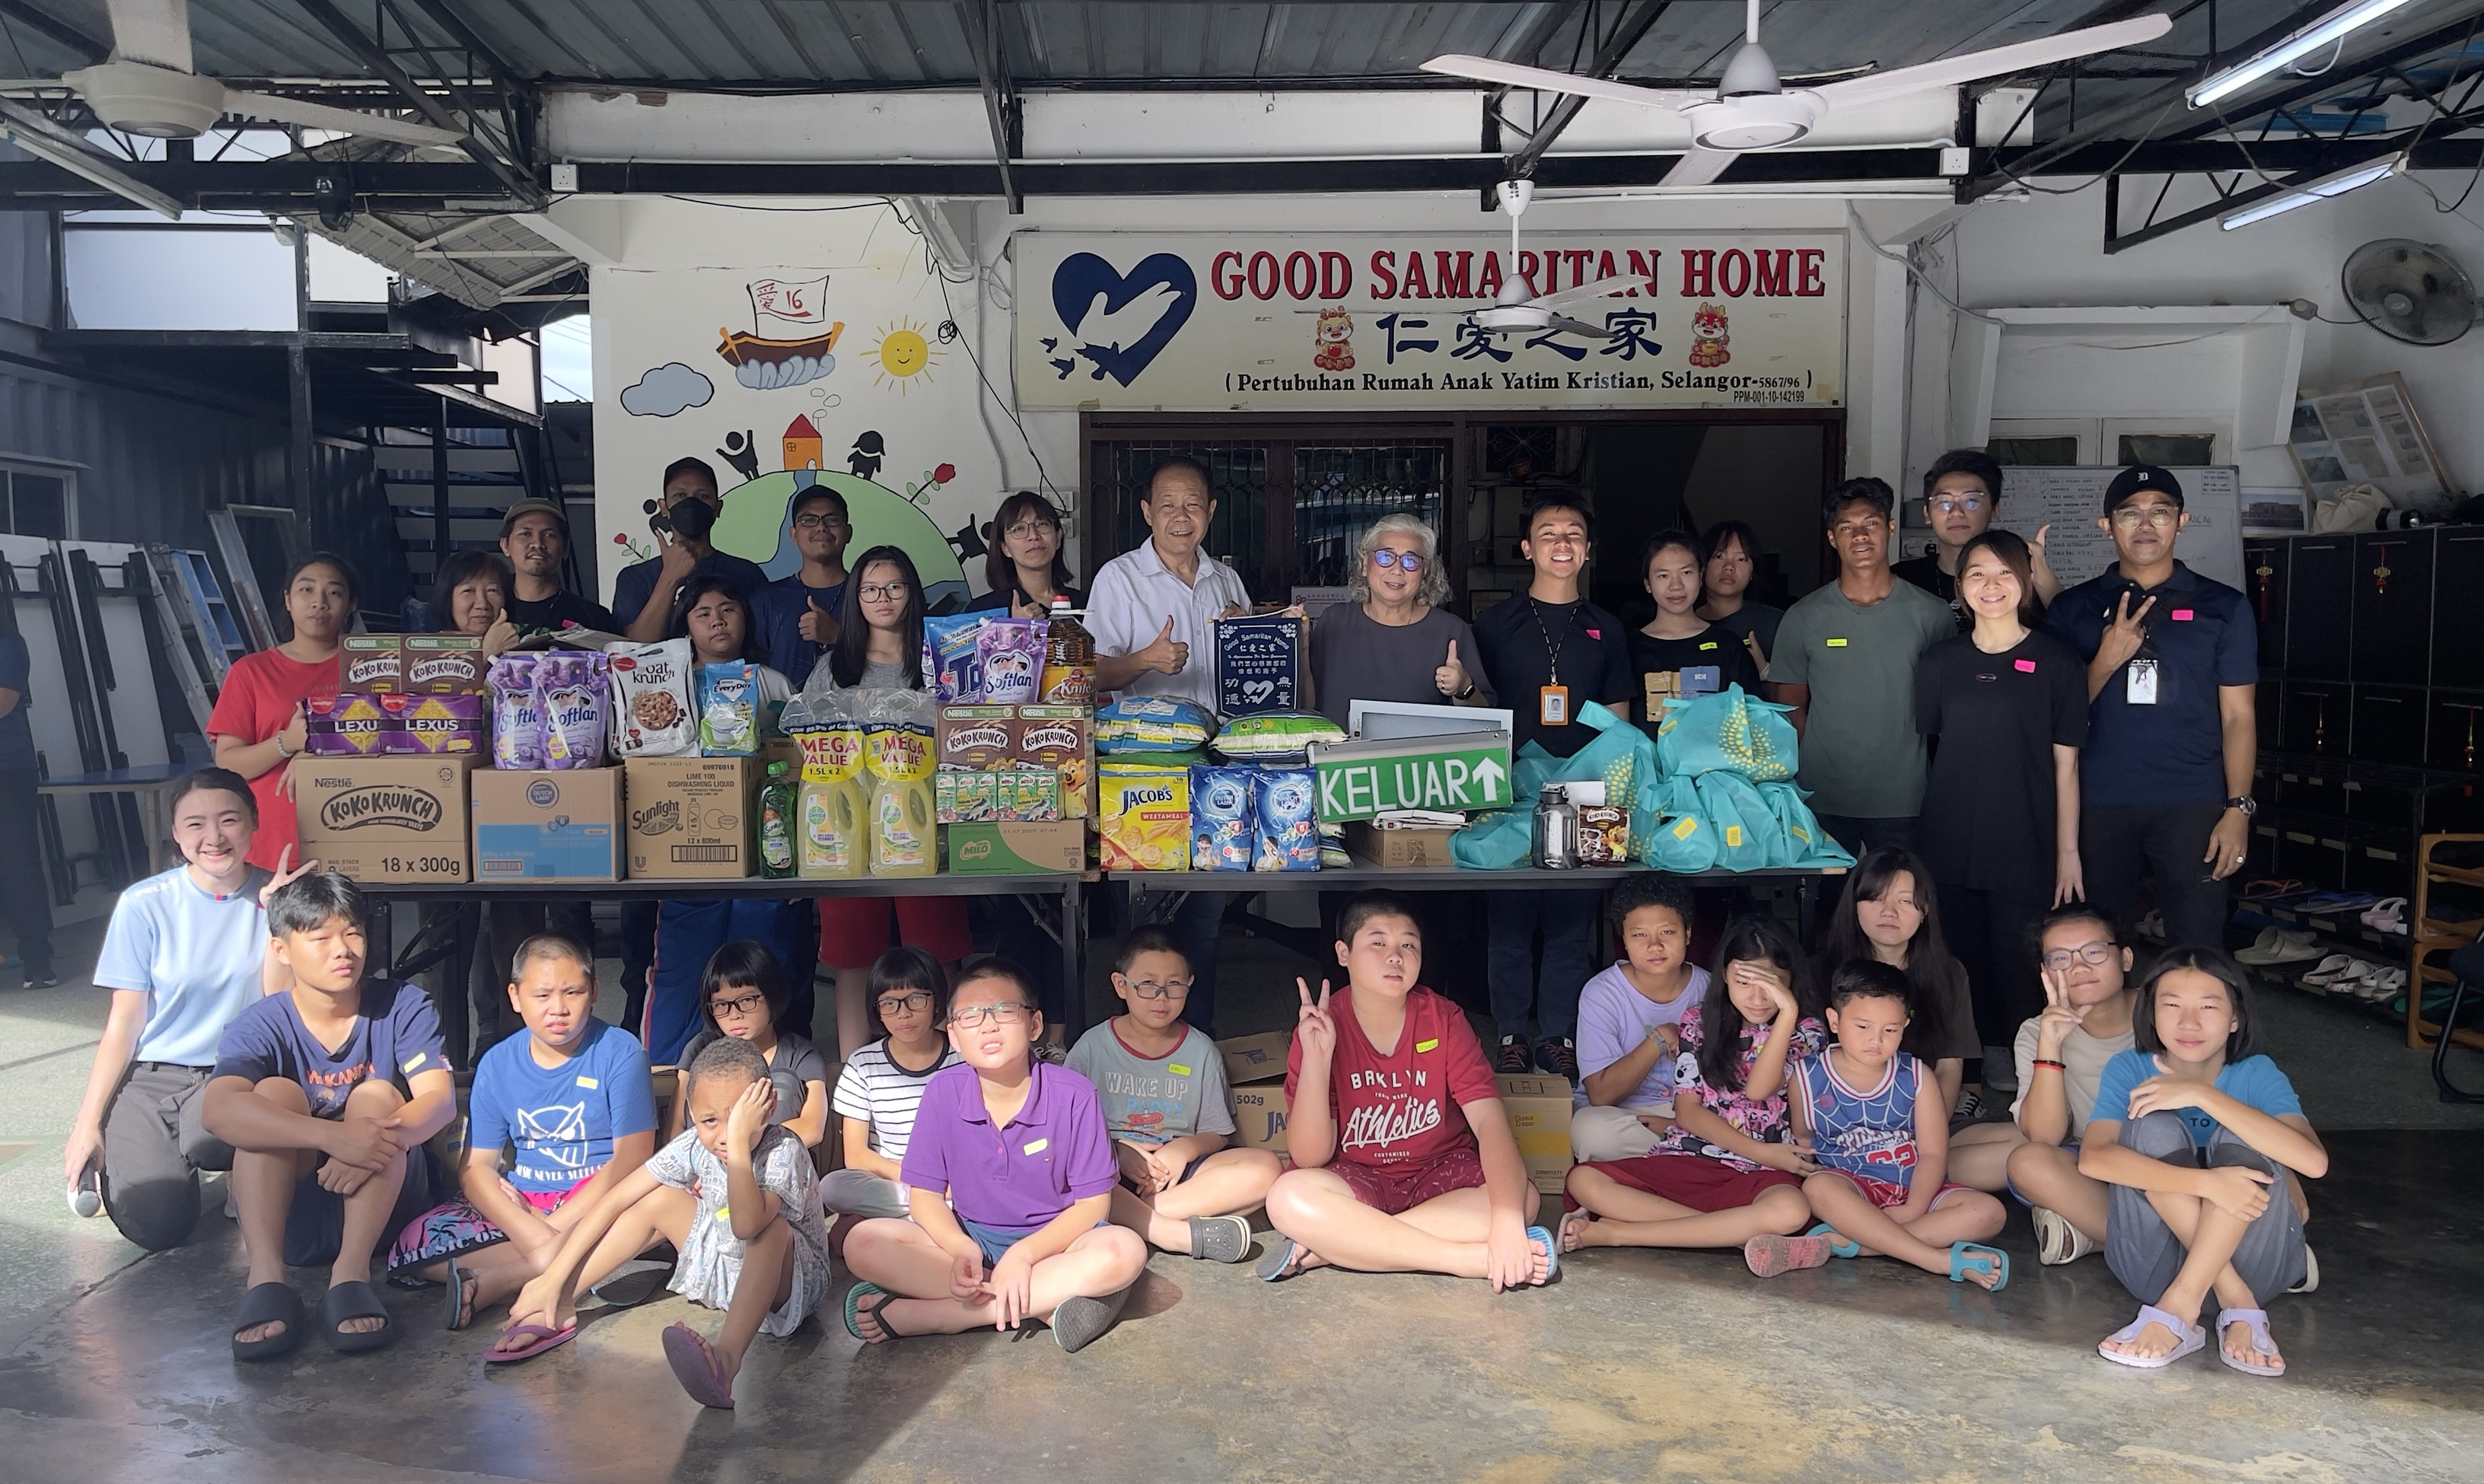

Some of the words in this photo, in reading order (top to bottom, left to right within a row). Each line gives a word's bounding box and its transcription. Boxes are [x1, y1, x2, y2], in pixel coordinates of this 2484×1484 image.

[1211, 250, 1352, 301] GOOD
[1370, 250, 1661, 300] SAMARITAN
[1680, 248, 1826, 298] HOME
[786, 289, 803, 310] 16
[1237, 373, 1356, 392] Pertubuhan
[1361, 373, 1434, 390] Rumah
[1441, 372, 1494, 390] Anak
[1501, 371, 1560, 390] Yatim
[1566, 371, 1654, 392] Kristian,
[1734, 390, 1804, 403] PPM-001-10-142199
[1241, 633, 1272, 642] Samaritan
[645, 661, 670, 675] oat
[632, 670, 675, 684] krunch
[985, 672, 1032, 694] Softlan
[713, 682, 752, 693] EveryDay
[1060, 681, 1092, 695] Knife
[405, 719, 459, 733] LEXUS
[801, 737, 859, 753] MEGA
[884, 735, 927, 756] MEGA
[803, 753, 849, 766] VALUE
[881, 752, 922, 766] VALUE
[1319, 758, 1472, 817] KELUAR
[1118, 788, 1174, 816] JACOB'S
[632, 799, 680, 830] Sunlight
[963, 845, 989, 855] MILO
[381, 857, 400, 873] 18
[406, 861, 415, 872] x
[419, 857, 460, 876] 300g
[1105, 1072, 1158, 1098] WAKE
[1164, 1077, 1189, 1101] UP
[1126, 1097, 1185, 1118] PARTY
[1236, 1094, 1264, 1106] 502g
[1260, 1110, 1288, 1142] JA
[1341, 1096, 1441, 1153] Athletics
[2189, 1117, 2211, 1128] TO
[534, 1169, 565, 1181] NEVER
[403, 1238, 470, 1267] MUSIC
[474, 1229, 504, 1244] ON
